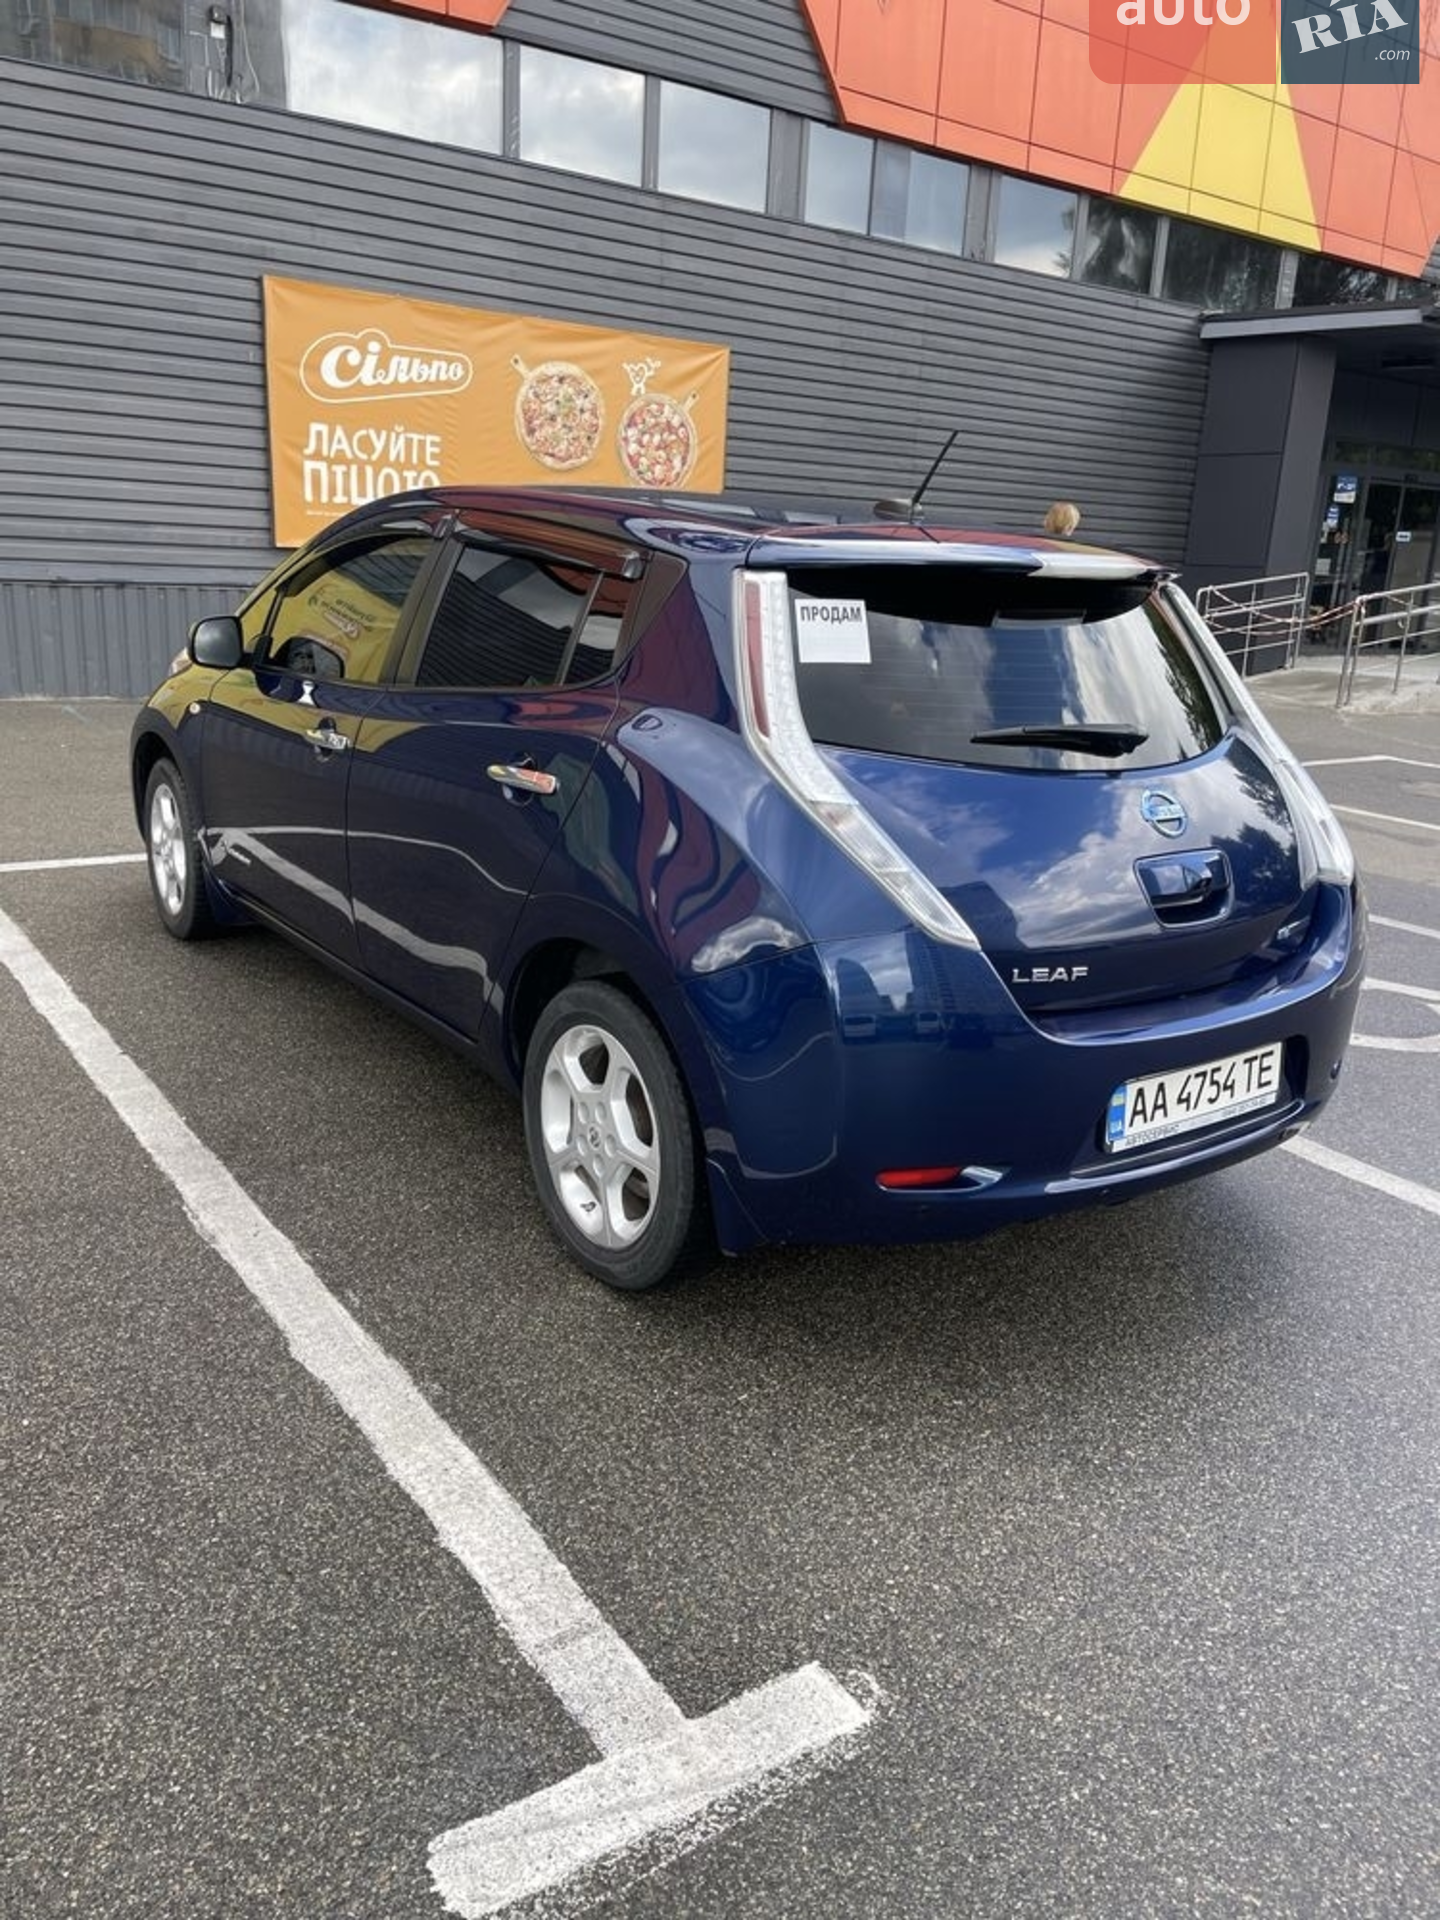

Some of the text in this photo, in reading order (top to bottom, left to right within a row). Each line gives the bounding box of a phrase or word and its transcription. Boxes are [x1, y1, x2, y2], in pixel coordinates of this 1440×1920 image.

[319, 341, 464, 389] Сільпо
[303, 422, 442, 467] ЛАСУЙТЕ
[800, 606, 862, 624] ПРОДАМ
[1012, 966, 1090, 984] LEAF
[1128, 1081, 1168, 1128] AA
[1176, 1061, 1237, 1112] 4754
[1243, 1049, 1275, 1094] TE
